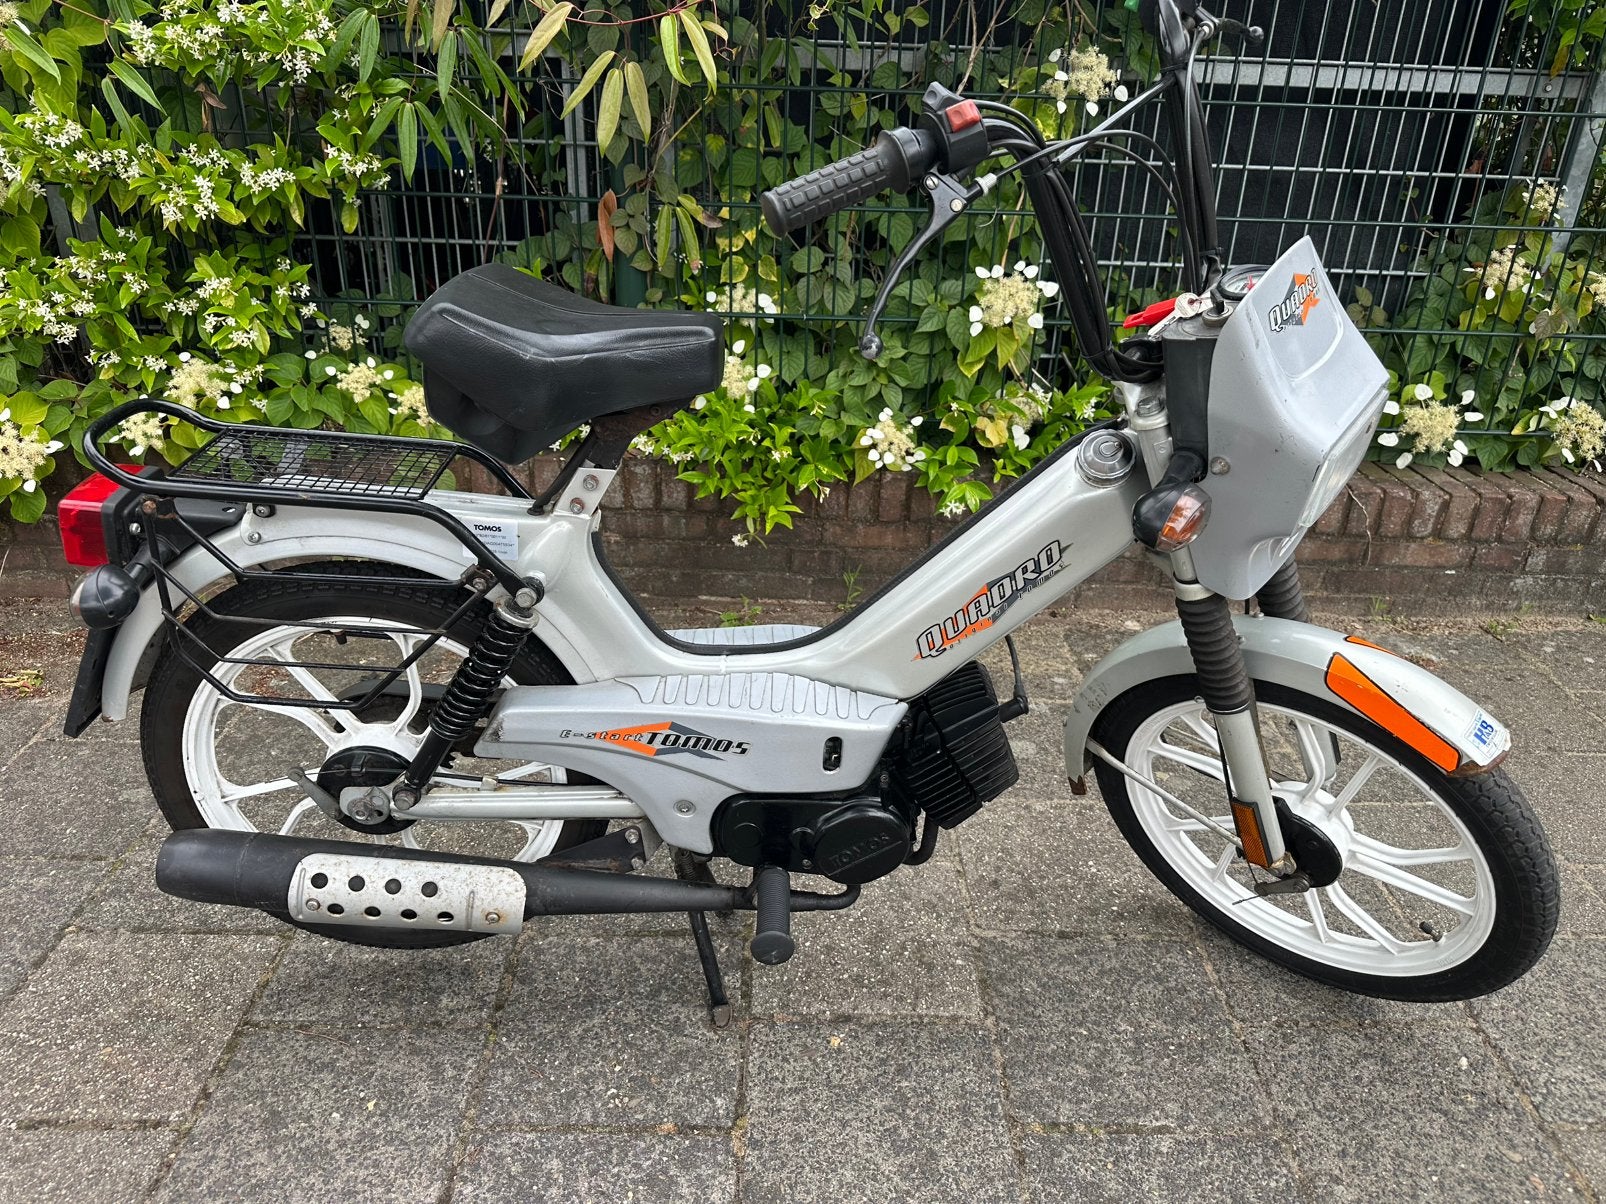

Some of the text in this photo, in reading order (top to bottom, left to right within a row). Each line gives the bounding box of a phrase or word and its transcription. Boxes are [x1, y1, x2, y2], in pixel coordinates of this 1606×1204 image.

[474, 524, 502, 532] TOMOS
[917, 540, 1062, 658] QUADRO
[560, 729, 752, 755] E-start TOMOS
[828, 830, 891, 868] TOMOS
